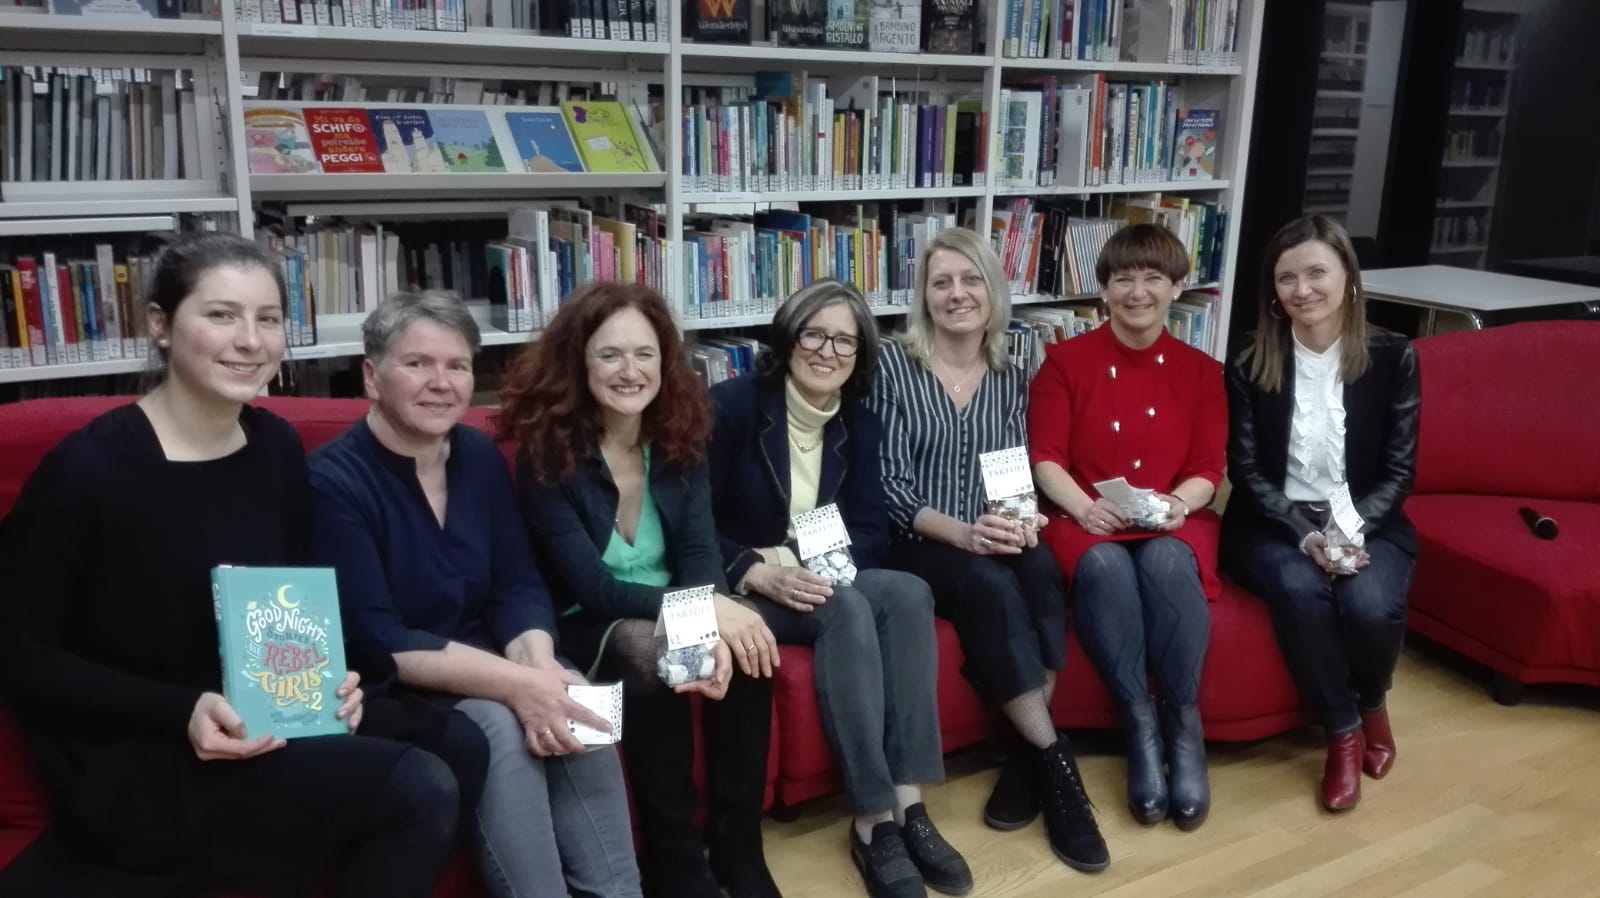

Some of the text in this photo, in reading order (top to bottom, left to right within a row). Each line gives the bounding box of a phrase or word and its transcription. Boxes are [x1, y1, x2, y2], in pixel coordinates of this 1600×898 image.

[879, 21, 916, 32] BAMBINO
[312, 123, 366, 133] SCHIFO
[276, 608, 327, 643] NIGHT
[263, 642, 327, 676] REBEL
[253, 662, 329, 706] GIRLS
